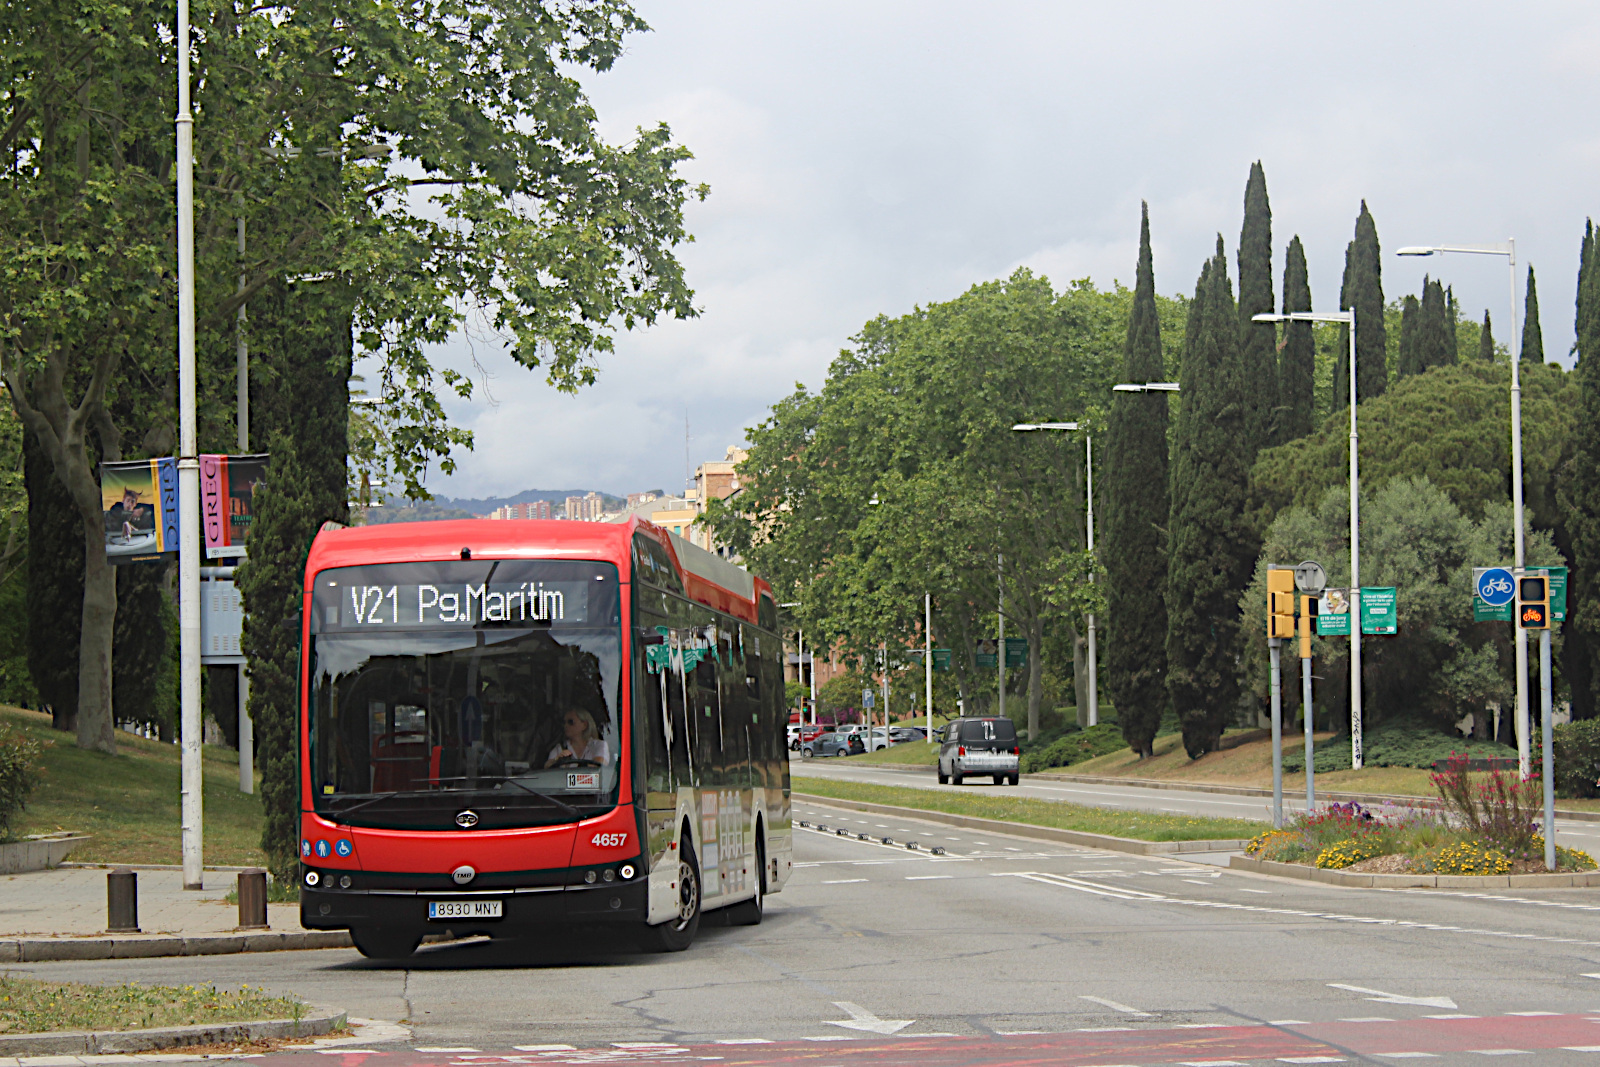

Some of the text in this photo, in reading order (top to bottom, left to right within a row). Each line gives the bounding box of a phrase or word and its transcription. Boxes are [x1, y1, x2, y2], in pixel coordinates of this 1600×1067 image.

[162, 462, 178, 546] GREC
[204, 459, 219, 543] GREC
[351, 582, 564, 623] V21 Pg.Marítim
[864, 690, 872, 700] P
[568, 774, 576, 786] 13
[591, 833, 628, 846] 4657
[438, 902, 499, 916] 8930 MNY
